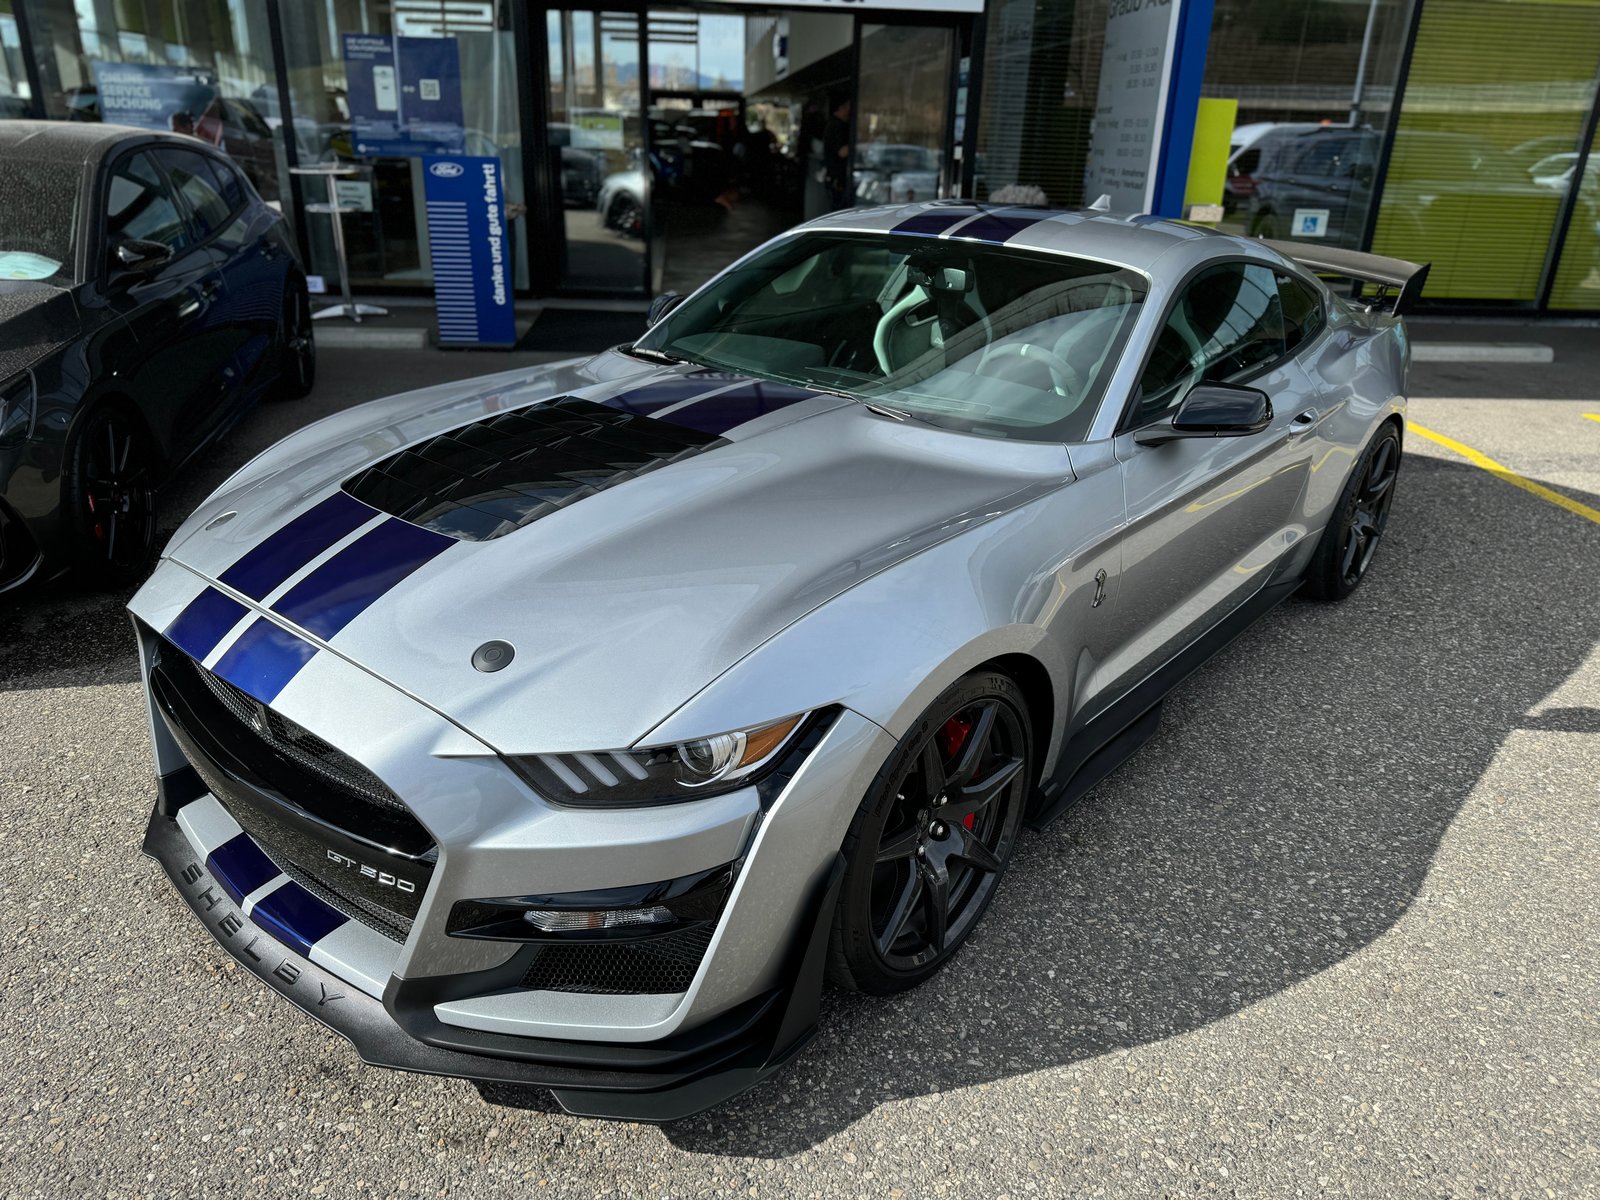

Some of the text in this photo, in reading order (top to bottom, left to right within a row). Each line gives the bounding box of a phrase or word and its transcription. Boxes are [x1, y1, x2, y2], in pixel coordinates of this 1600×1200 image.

[101, 84, 152, 98] SERVICE
[103, 97, 162, 110] BUCHUNG
[482, 163, 506, 306] danke und gute fahrt!
[180, 862, 346, 1006] SHELBY
